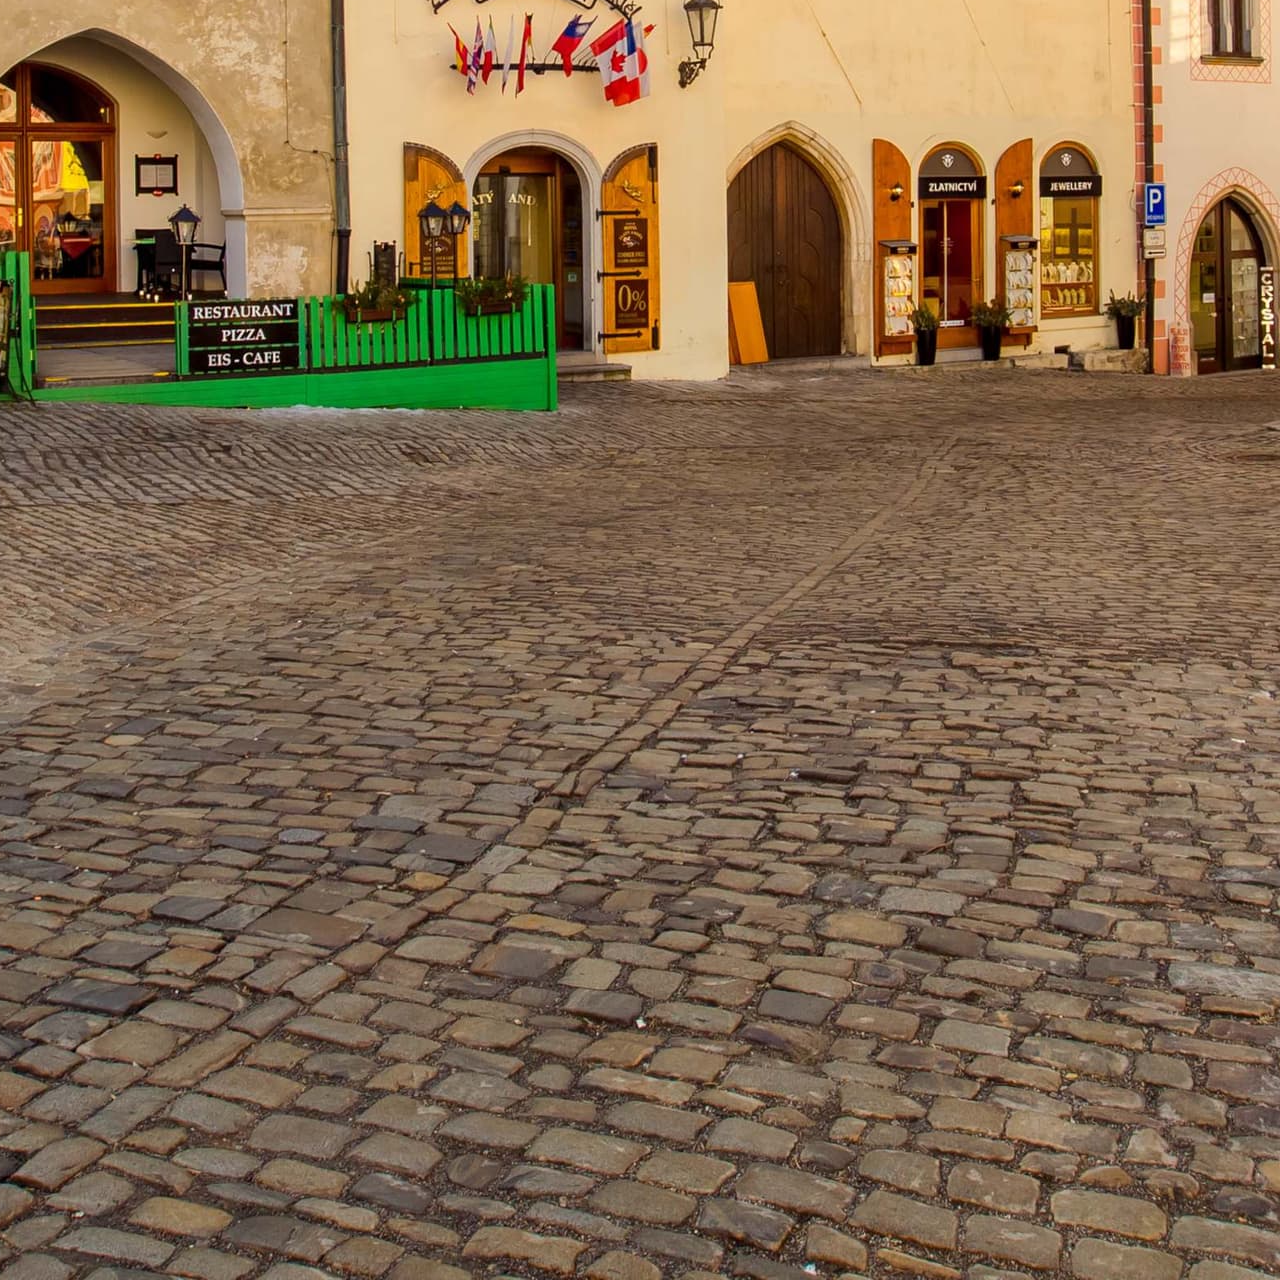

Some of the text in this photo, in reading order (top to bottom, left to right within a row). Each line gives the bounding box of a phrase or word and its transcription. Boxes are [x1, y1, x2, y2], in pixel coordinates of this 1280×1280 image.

[928, 180, 978, 193] ZLATNICTVÍ
[1050, 181, 1093, 192] JEWELLERY
[1149, 188, 1162, 213] P
[618, 285, 647, 312] 0%
[193, 304, 294, 320] RESTAURANT
[1261, 273, 1276, 358] CRYSTAL
[222, 328, 267, 343] PIZZA
[208, 353, 232, 367] EIS
[243, 351, 281, 365] CAFE
